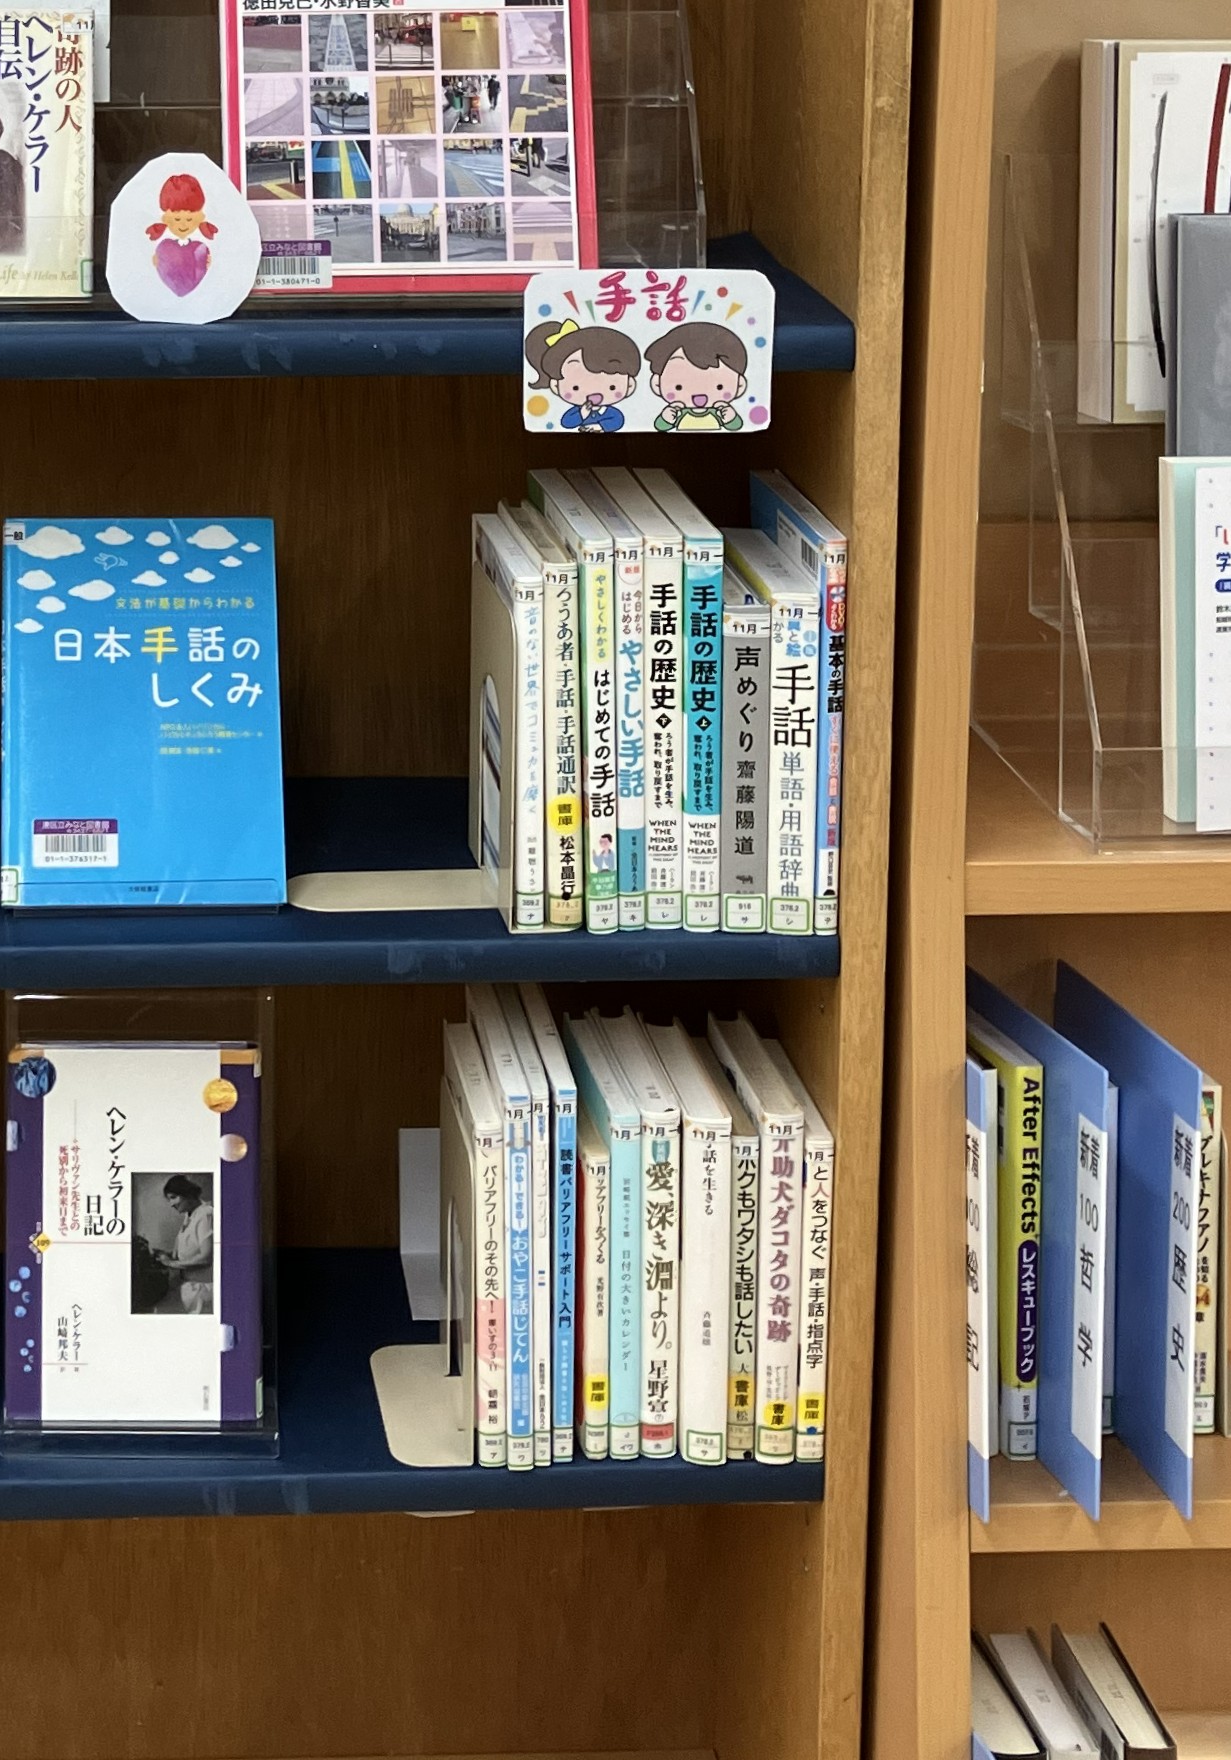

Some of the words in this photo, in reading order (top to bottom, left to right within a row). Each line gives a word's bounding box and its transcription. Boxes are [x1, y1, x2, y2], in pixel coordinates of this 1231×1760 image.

[22, 15, 54, 193] ヘレン・ケラー
[595, 270, 689, 322] 手話
[54, 626, 261, 664] 日本手話の
[152, 672, 263, 708] しくみ
[649, 583, 678, 710] 手話の歴史
[690, 585, 719, 712] 手話の歴史
[555, 587, 576, 795] ろうあ者・手話・手話通訳
[618, 640, 645, 798] やさしい手話
[734, 645, 762, 752] 声めぐり
[772, 663, 816, 748] 手話
[590, 669, 615, 818] はじめての手話
[647, 844, 679, 852] HEARS
[648, 819, 677, 827] WHEN
[649, 836, 676, 844] MIND
[653, 828, 672, 836] THE
[686, 847, 718, 855] HEARS
[692, 830, 712, 838] THE
[734, 760, 757, 855] 齋藤陽道
[1022, 1076, 1041, 1141] After
[83, 1194, 105, 1237] 日記
[105, 1106, 127, 1235] ヘレン・ケラーの
[1020, 1147, 1041, 1234] Effects
[558, 1149, 574, 1329] 読書バリアフリーサポート入門
[511, 1240, 529, 1364] おやこ手話じてん
[805, 1268, 826, 1368] 声・手話・指点字
[1020, 1247, 1037, 1375] レスキューブック
